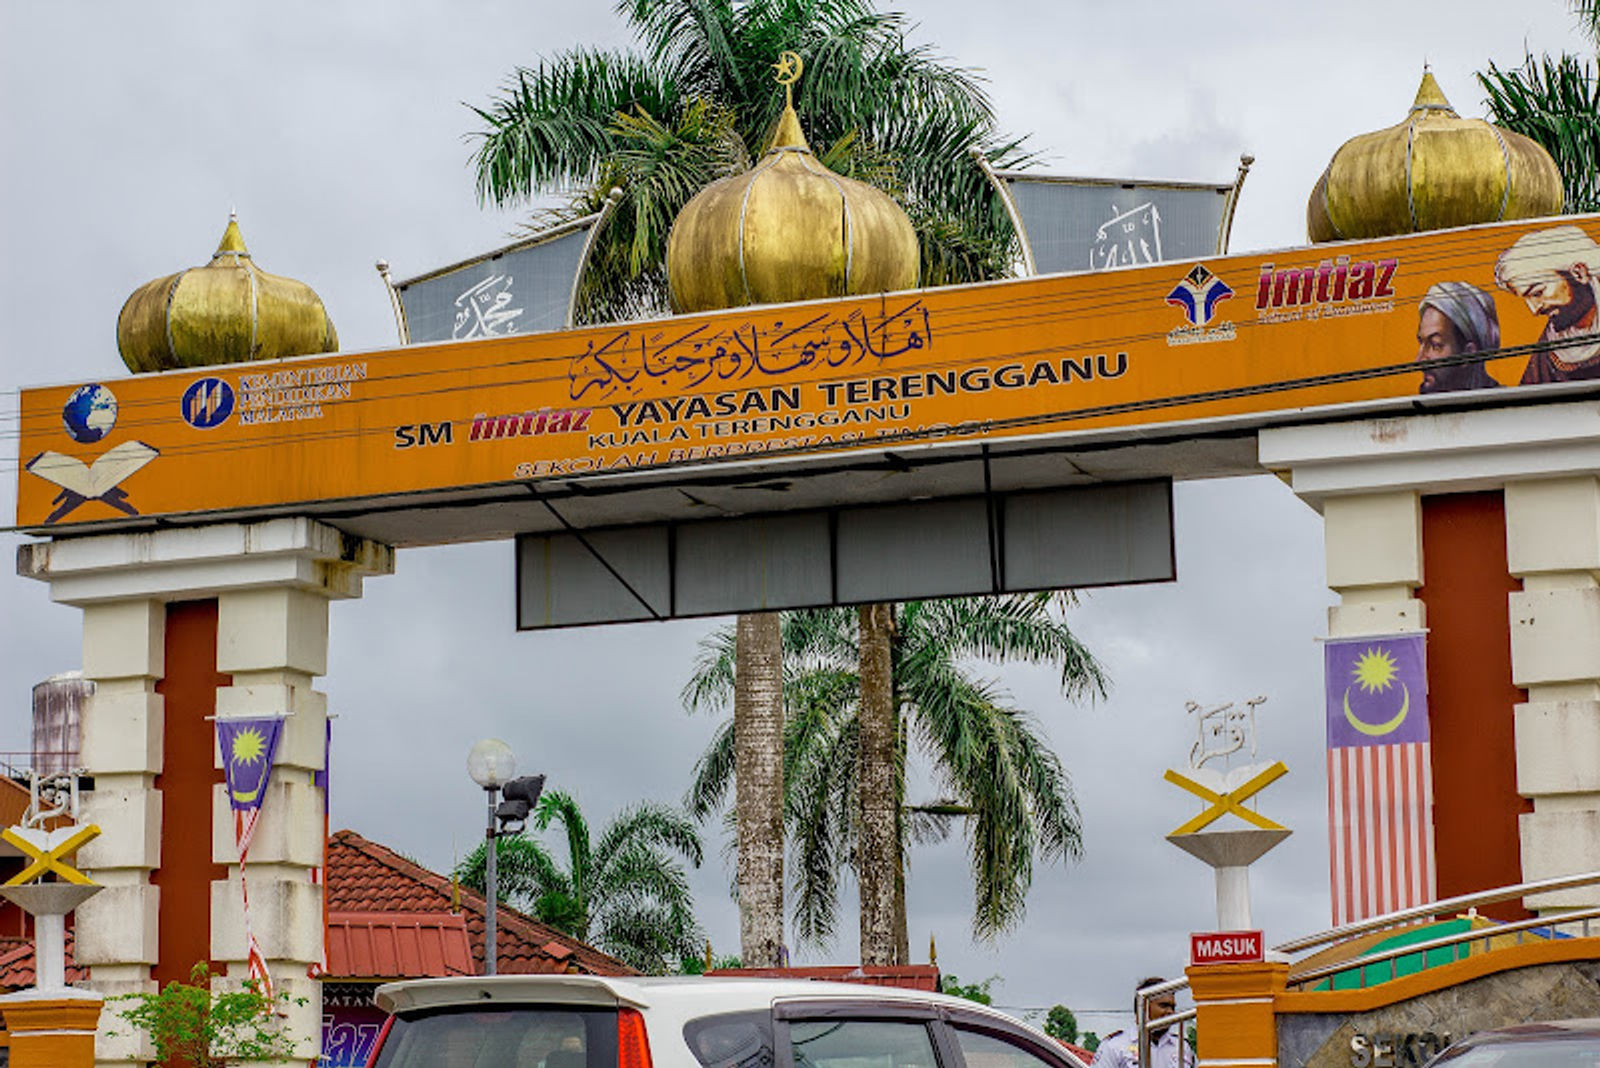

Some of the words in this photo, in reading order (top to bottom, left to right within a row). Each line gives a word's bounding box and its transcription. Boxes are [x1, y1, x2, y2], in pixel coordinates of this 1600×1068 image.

[1255, 254, 1398, 311] imtiaz
[239, 362, 367, 391] KEMENTERIAN
[239, 381, 351, 407] PENDIDIKAN
[394, 421, 453, 449] SM
[469, 406, 593, 442] imtiaz
[611, 386, 800, 428] YAYASAN
[818, 352, 1130, 408] TERENGGANU
[239, 403, 324, 426] MALAYSIA
[588, 425, 690, 450] KUALA
[694, 404, 911, 440] TERENGGANU
[513, 450, 658, 478] SEKOLAH
[1196, 937, 1257, 958] MASUK
